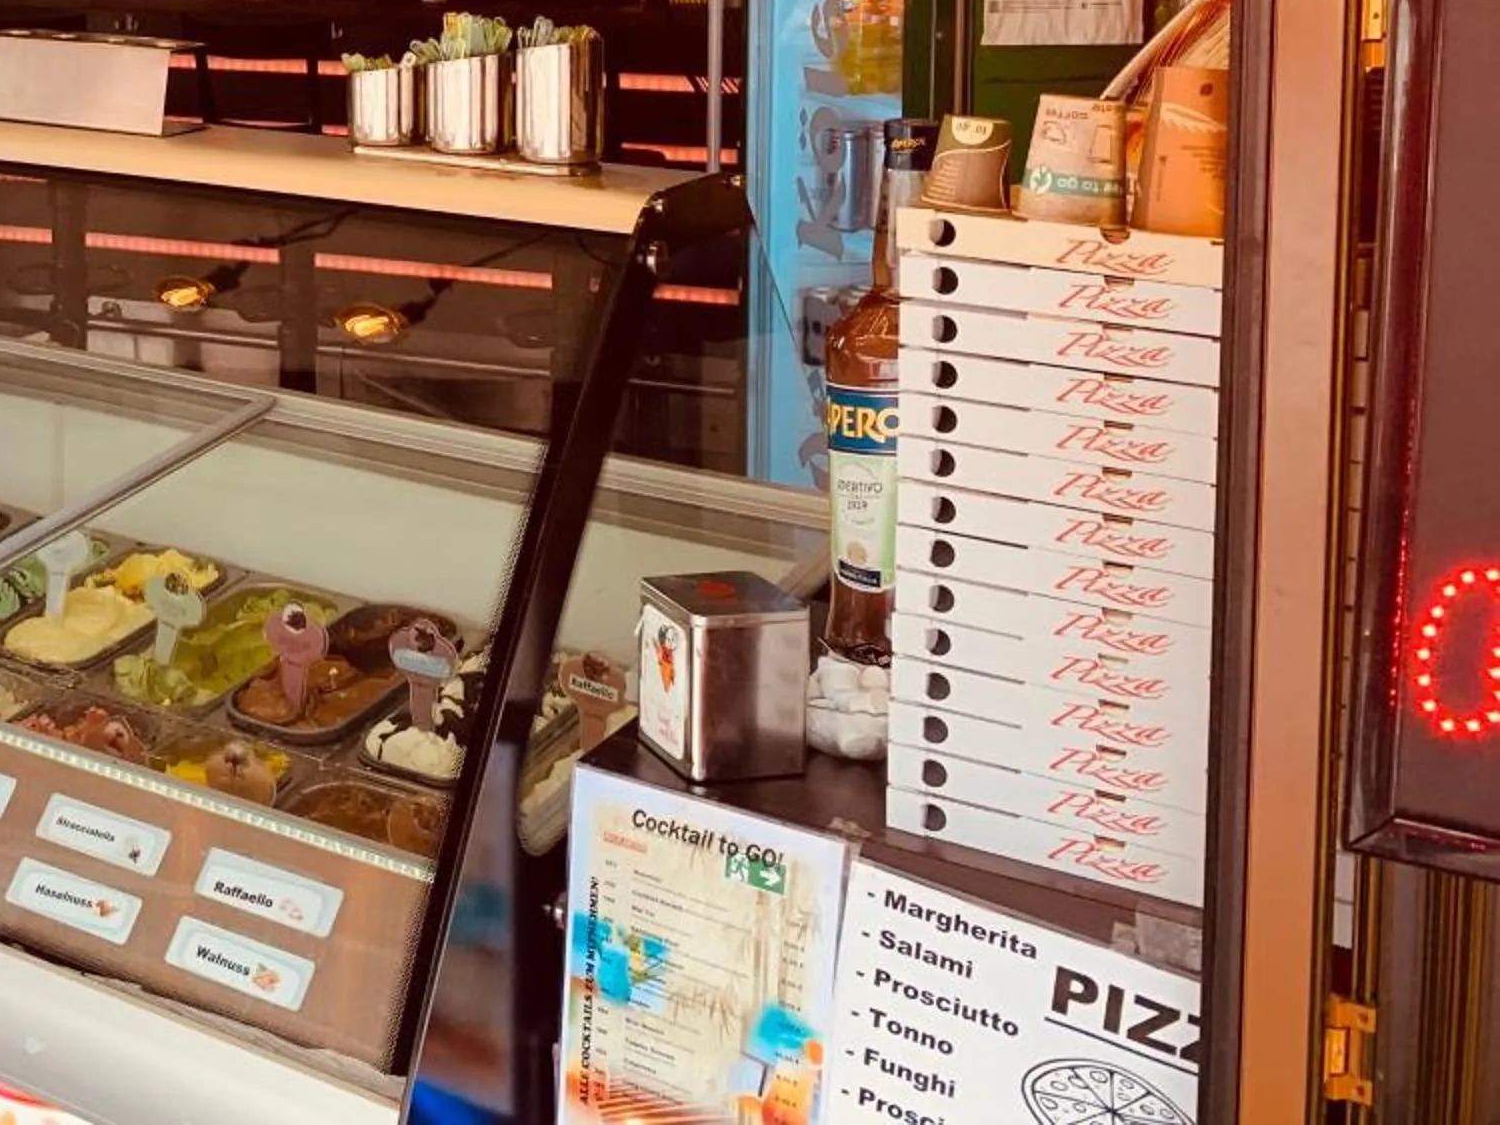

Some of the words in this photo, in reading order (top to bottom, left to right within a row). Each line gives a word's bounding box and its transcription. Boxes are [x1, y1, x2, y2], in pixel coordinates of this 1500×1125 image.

[1056, 238, 1176, 275] Pizza
[1058, 284, 1176, 320] Pizza
[1057, 331, 1176, 368] Pizza
[1055, 378, 1174, 416] Pizza
[1055, 425, 1176, 464] Pizza
[1053, 472, 1173, 512] Pizza
[1055, 519, 1174, 560] Pizza
[1054, 565, 1175, 609] Pizza
[1053, 612, 1175, 656] Pizza
[1051, 656, 1173, 701] Pizza
[1051, 702, 1173, 748] Pizza
[1049, 747, 1169, 793] Pizza
[1047, 790, 1168, 836] Pizza
[631, 808, 715, 854] Cocktail
[718, 834, 740, 859] to
[744, 843, 786, 870] GO!
[1047, 837, 1170, 884] Pizza
[34, 883, 94, 909] Haselnuss
[213, 880, 274, 909] Raffaello
[883, 889, 1038, 960] Margherita
[195, 944, 251, 977] Walnuss
[879, 930, 974, 980] Salami
[873, 967, 1020, 1038] Prosciutto
[581, 995, 595, 1069] COCKTAILS
[868, 1008, 955, 1056] Tonno
[863, 1047, 956, 1099] Funghi
